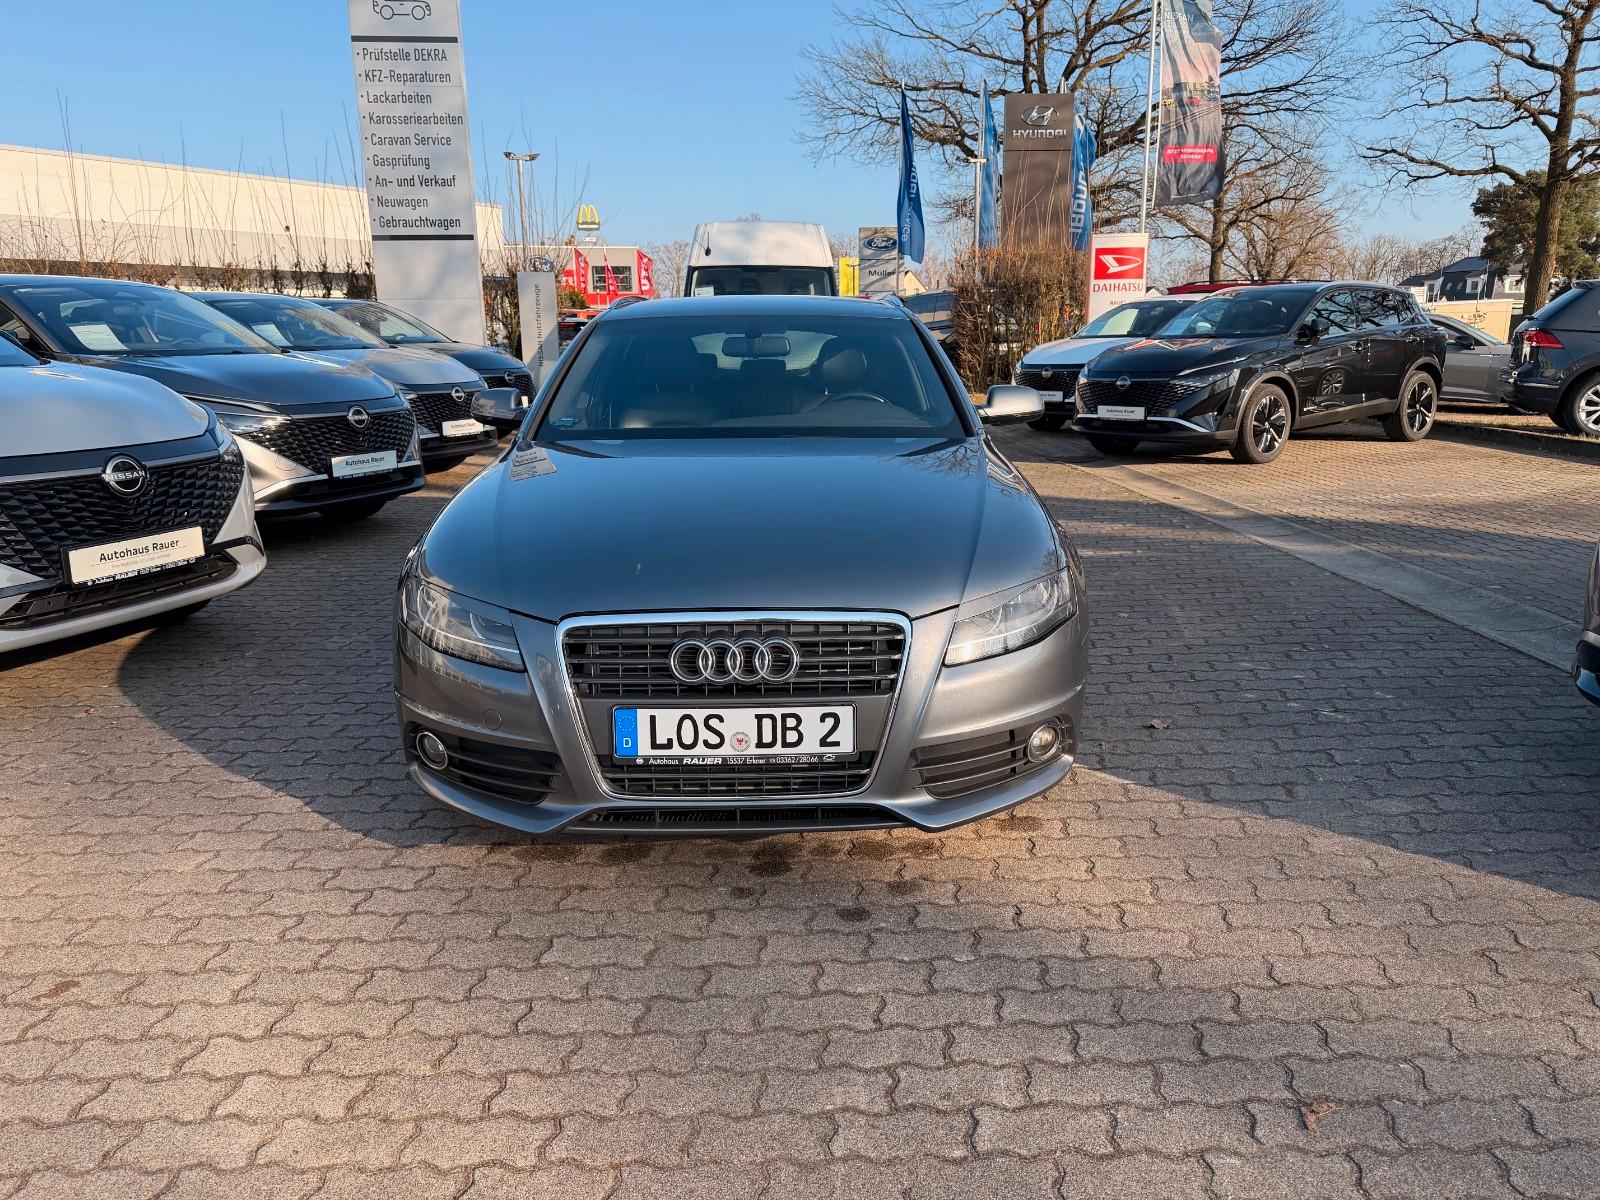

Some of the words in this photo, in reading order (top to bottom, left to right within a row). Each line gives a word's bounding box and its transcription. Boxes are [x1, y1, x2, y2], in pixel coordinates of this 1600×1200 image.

[1165, 11, 1194, 22] NISSAN
[362, 47, 411, 62] Prüfstelle
[413, 49, 448, 62] DEKRA
[364, 69, 451, 86] KFZ-Reparaturen
[366, 91, 432, 104] Lackarbeiten
[368, 112, 464, 126] Karosseriearbeiten
[370, 133, 411, 146] Caravan
[414, 133, 452, 146] Service
[1012, 129, 1067, 139] HYUNDAI
[372, 154, 431, 170] Gasprüfung
[374, 175, 394, 188] An-
[396, 175, 415, 187] und
[417, 174, 457, 188] Verkauf
[377, 195, 429, 211] Neuwagen
[378, 215, 461, 231] Gebrauchtwagen
[871, 237, 893, 247] Ford
[1092, 282, 1144, 293] DAIHATSU
[534, 283, 543, 338] Nutzfahrzeuge
[104, 470, 146, 481] NISSAN
[99, 546, 150, 562] Autohaus
[152, 539, 180, 552] Rauer
[622, 737, 632, 748] D
[649, 713, 726, 750] LOS
[754, 712, 804, 749] DB
[818, 711, 841, 748] 2
[648, 757, 679, 765] Autohaus
[682, 757, 723, 765] RAUER
[726, 757, 744, 765] 15537
[746, 756, 766, 764] Erkner
[776, 756, 819, 764] 03362/28066
